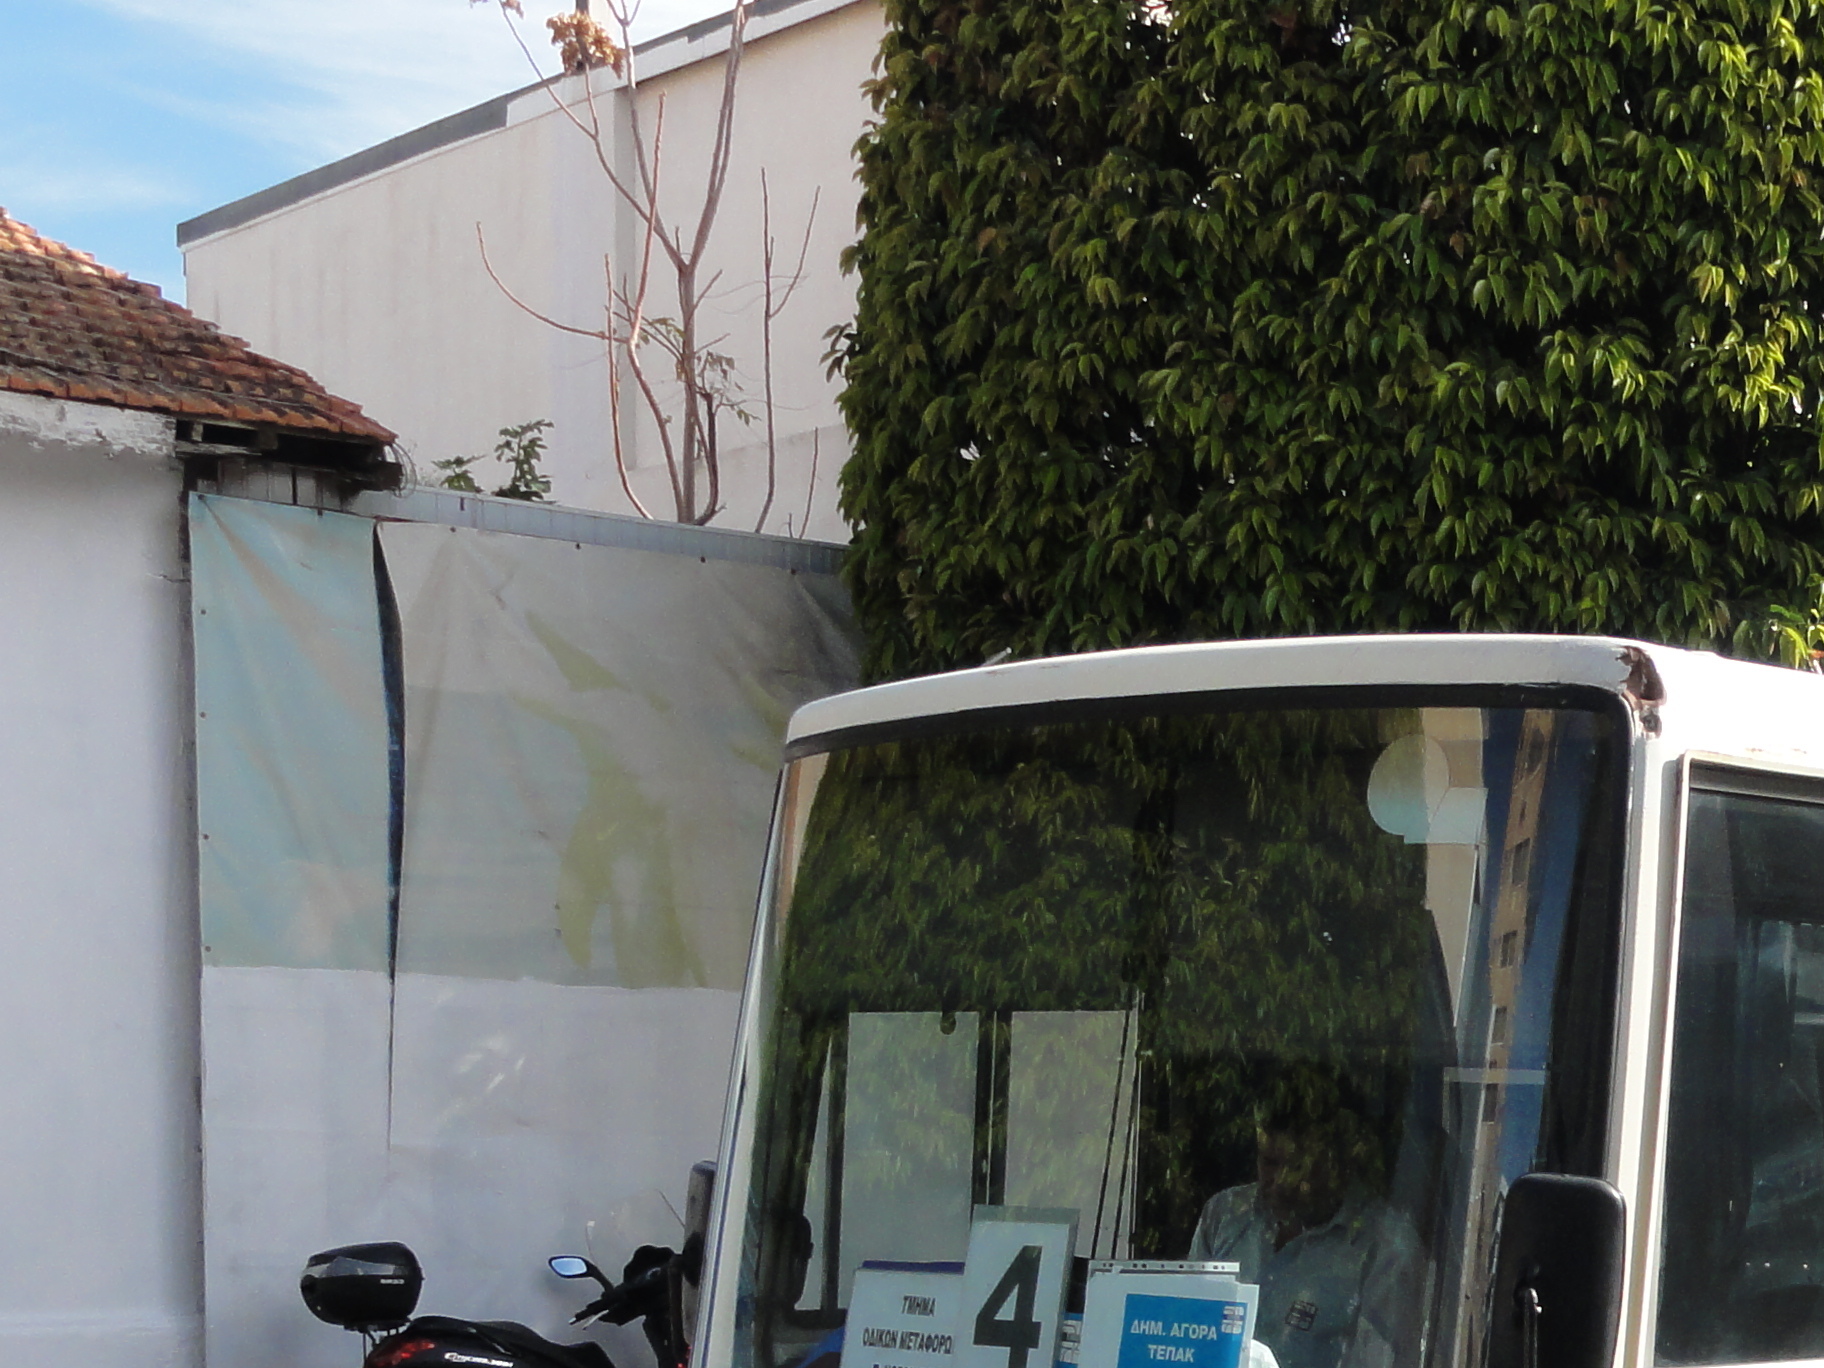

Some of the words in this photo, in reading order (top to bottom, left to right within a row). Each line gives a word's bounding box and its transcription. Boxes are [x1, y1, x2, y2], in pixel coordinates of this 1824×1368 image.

[901, 1295, 936, 1317] ΤΜΗΜΑ
[862, 1326, 898, 1349] ΟΔΙΚΩΝ
[899, 1329, 955, 1355] ΜΕΤΑΦΟΡΩ
[1130, 1319, 1166, 1338] ΔΗΜ.
[1170, 1323, 1218, 1342] ΑΓΟΡΑ
[1147, 1344, 1197, 1364] ΤΕΠΑΚ
